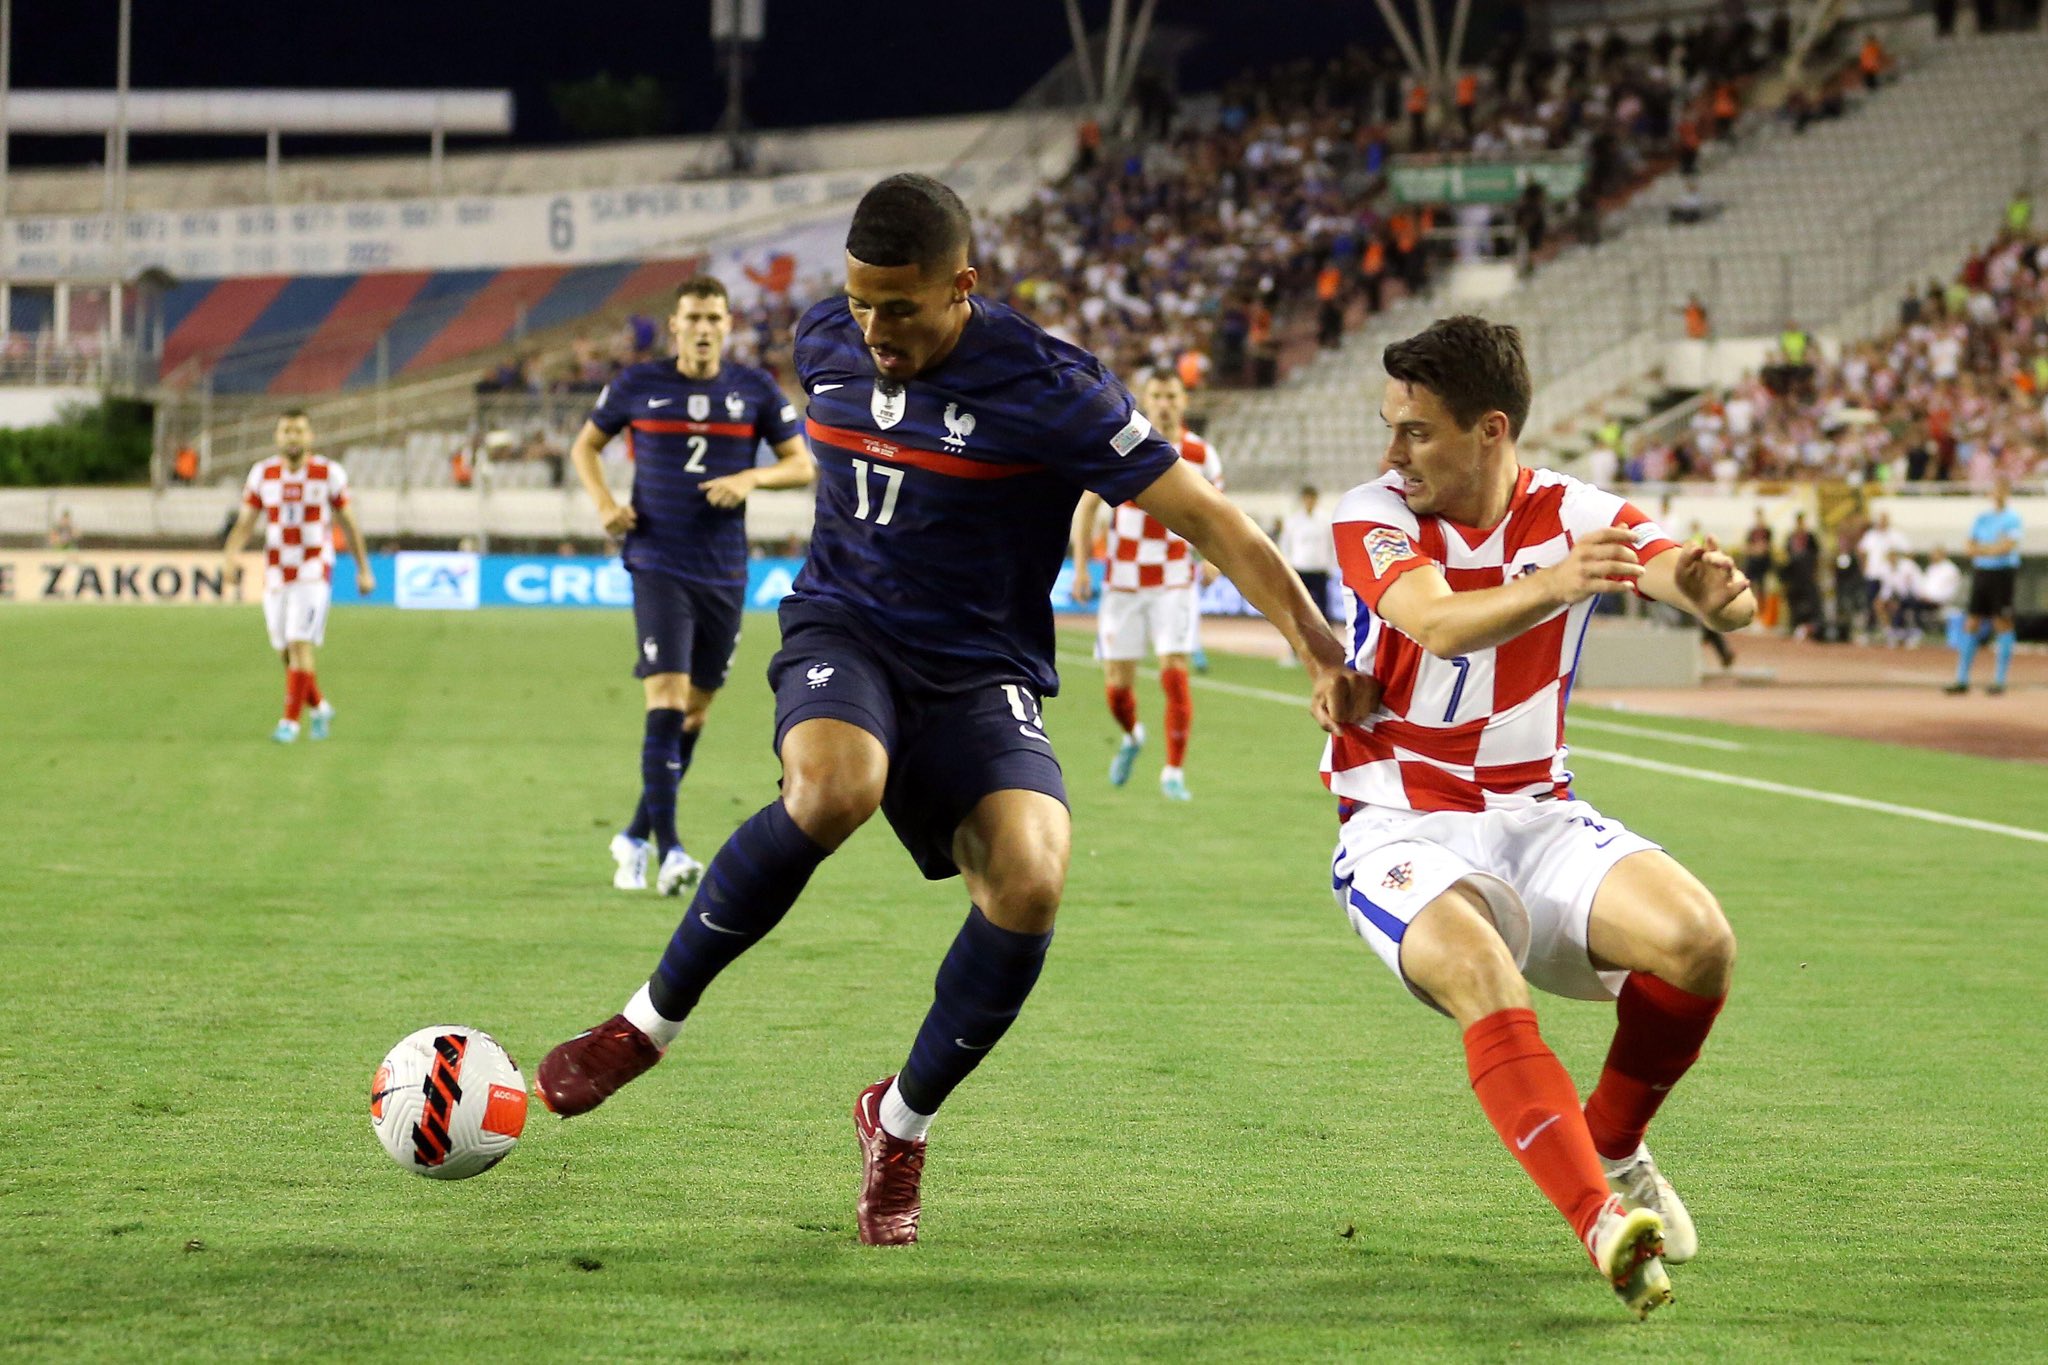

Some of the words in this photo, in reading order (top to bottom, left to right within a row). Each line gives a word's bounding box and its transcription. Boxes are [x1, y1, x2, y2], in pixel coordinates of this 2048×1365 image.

[547, 197, 576, 252] 6
[683, 435, 708, 474] 2
[851, 458, 905, 526] 17
[1442, 656, 1470, 723] 7
